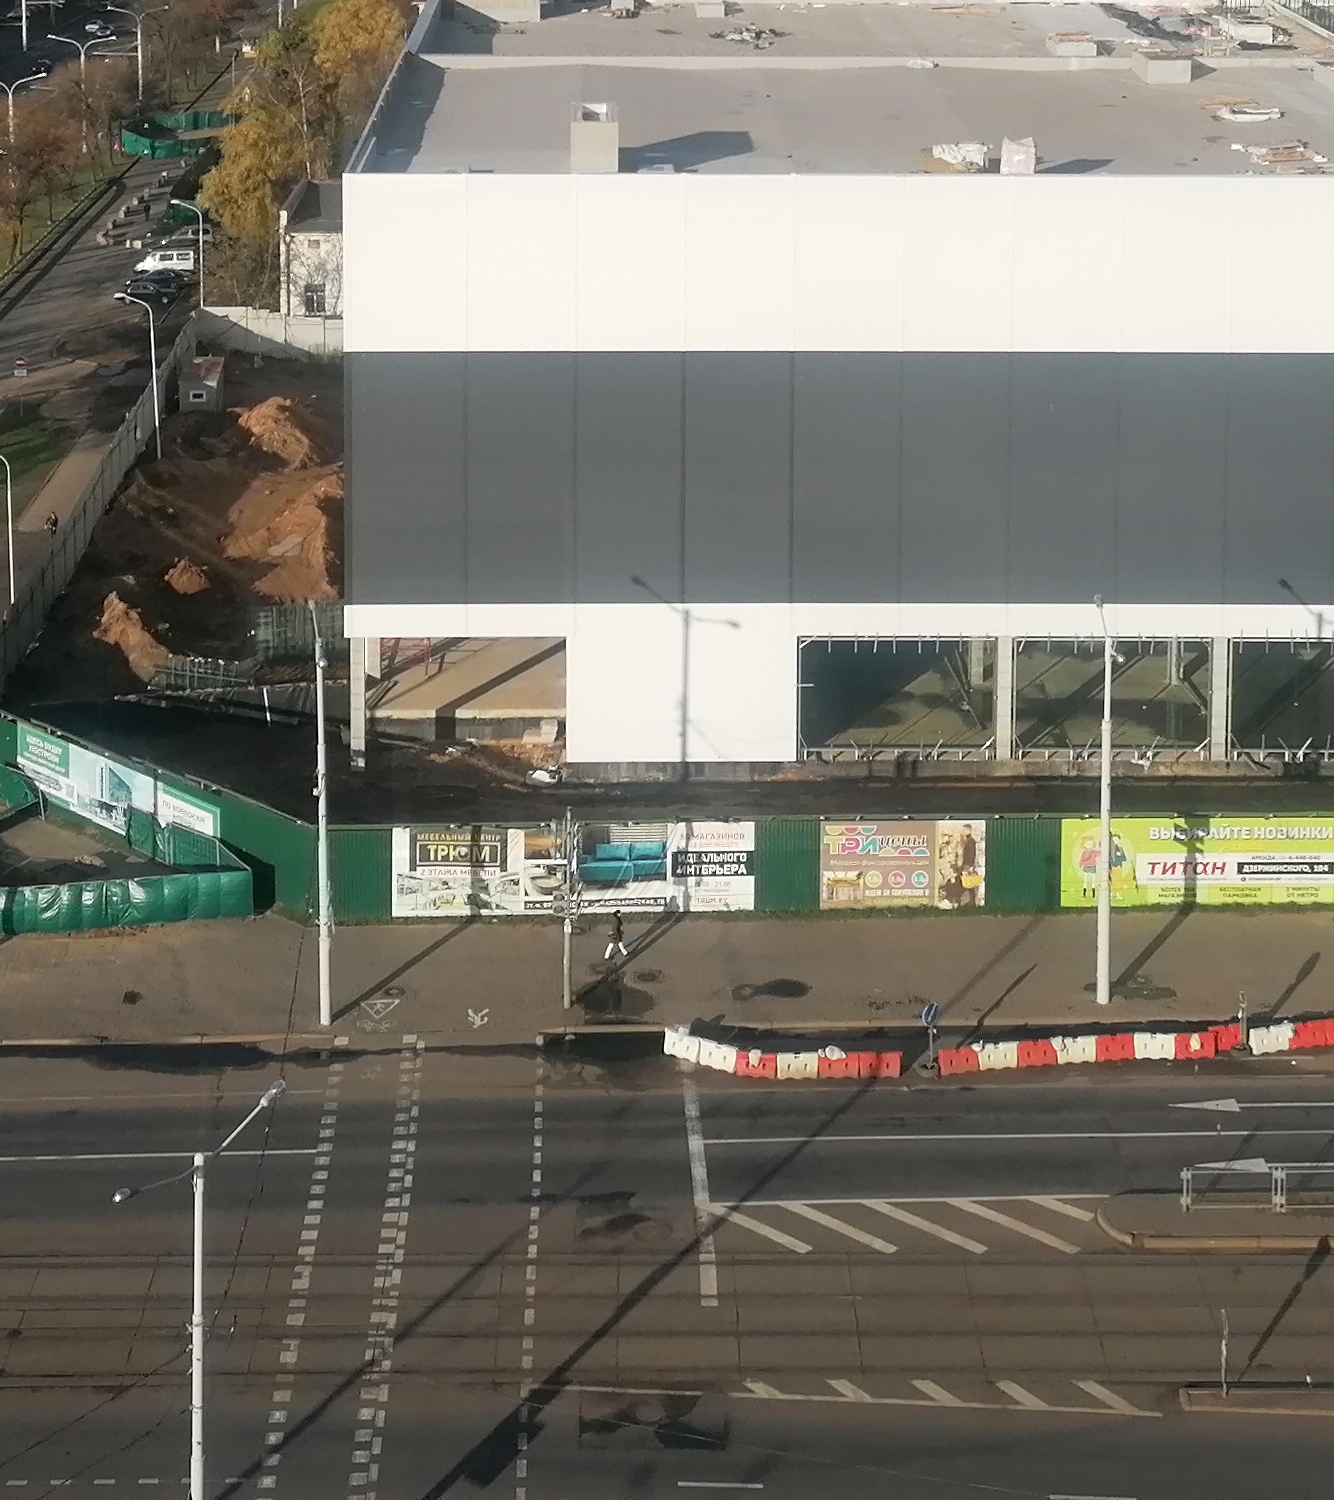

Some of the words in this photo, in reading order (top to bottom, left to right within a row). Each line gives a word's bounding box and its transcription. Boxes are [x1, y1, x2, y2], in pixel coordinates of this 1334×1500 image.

[1149, 825, 1251, 840] ВЫБИРАЙТЕ
[1253, 826, 1334, 840] НОВИНКИ
[824, 835, 880, 855] ТРИ
[678, 852, 747, 863] ИДЕАЛЬНОГО
[427, 868, 458, 876] ЭТАЖА
[677, 864, 747, 875] ИНТЕРЬЕРА
